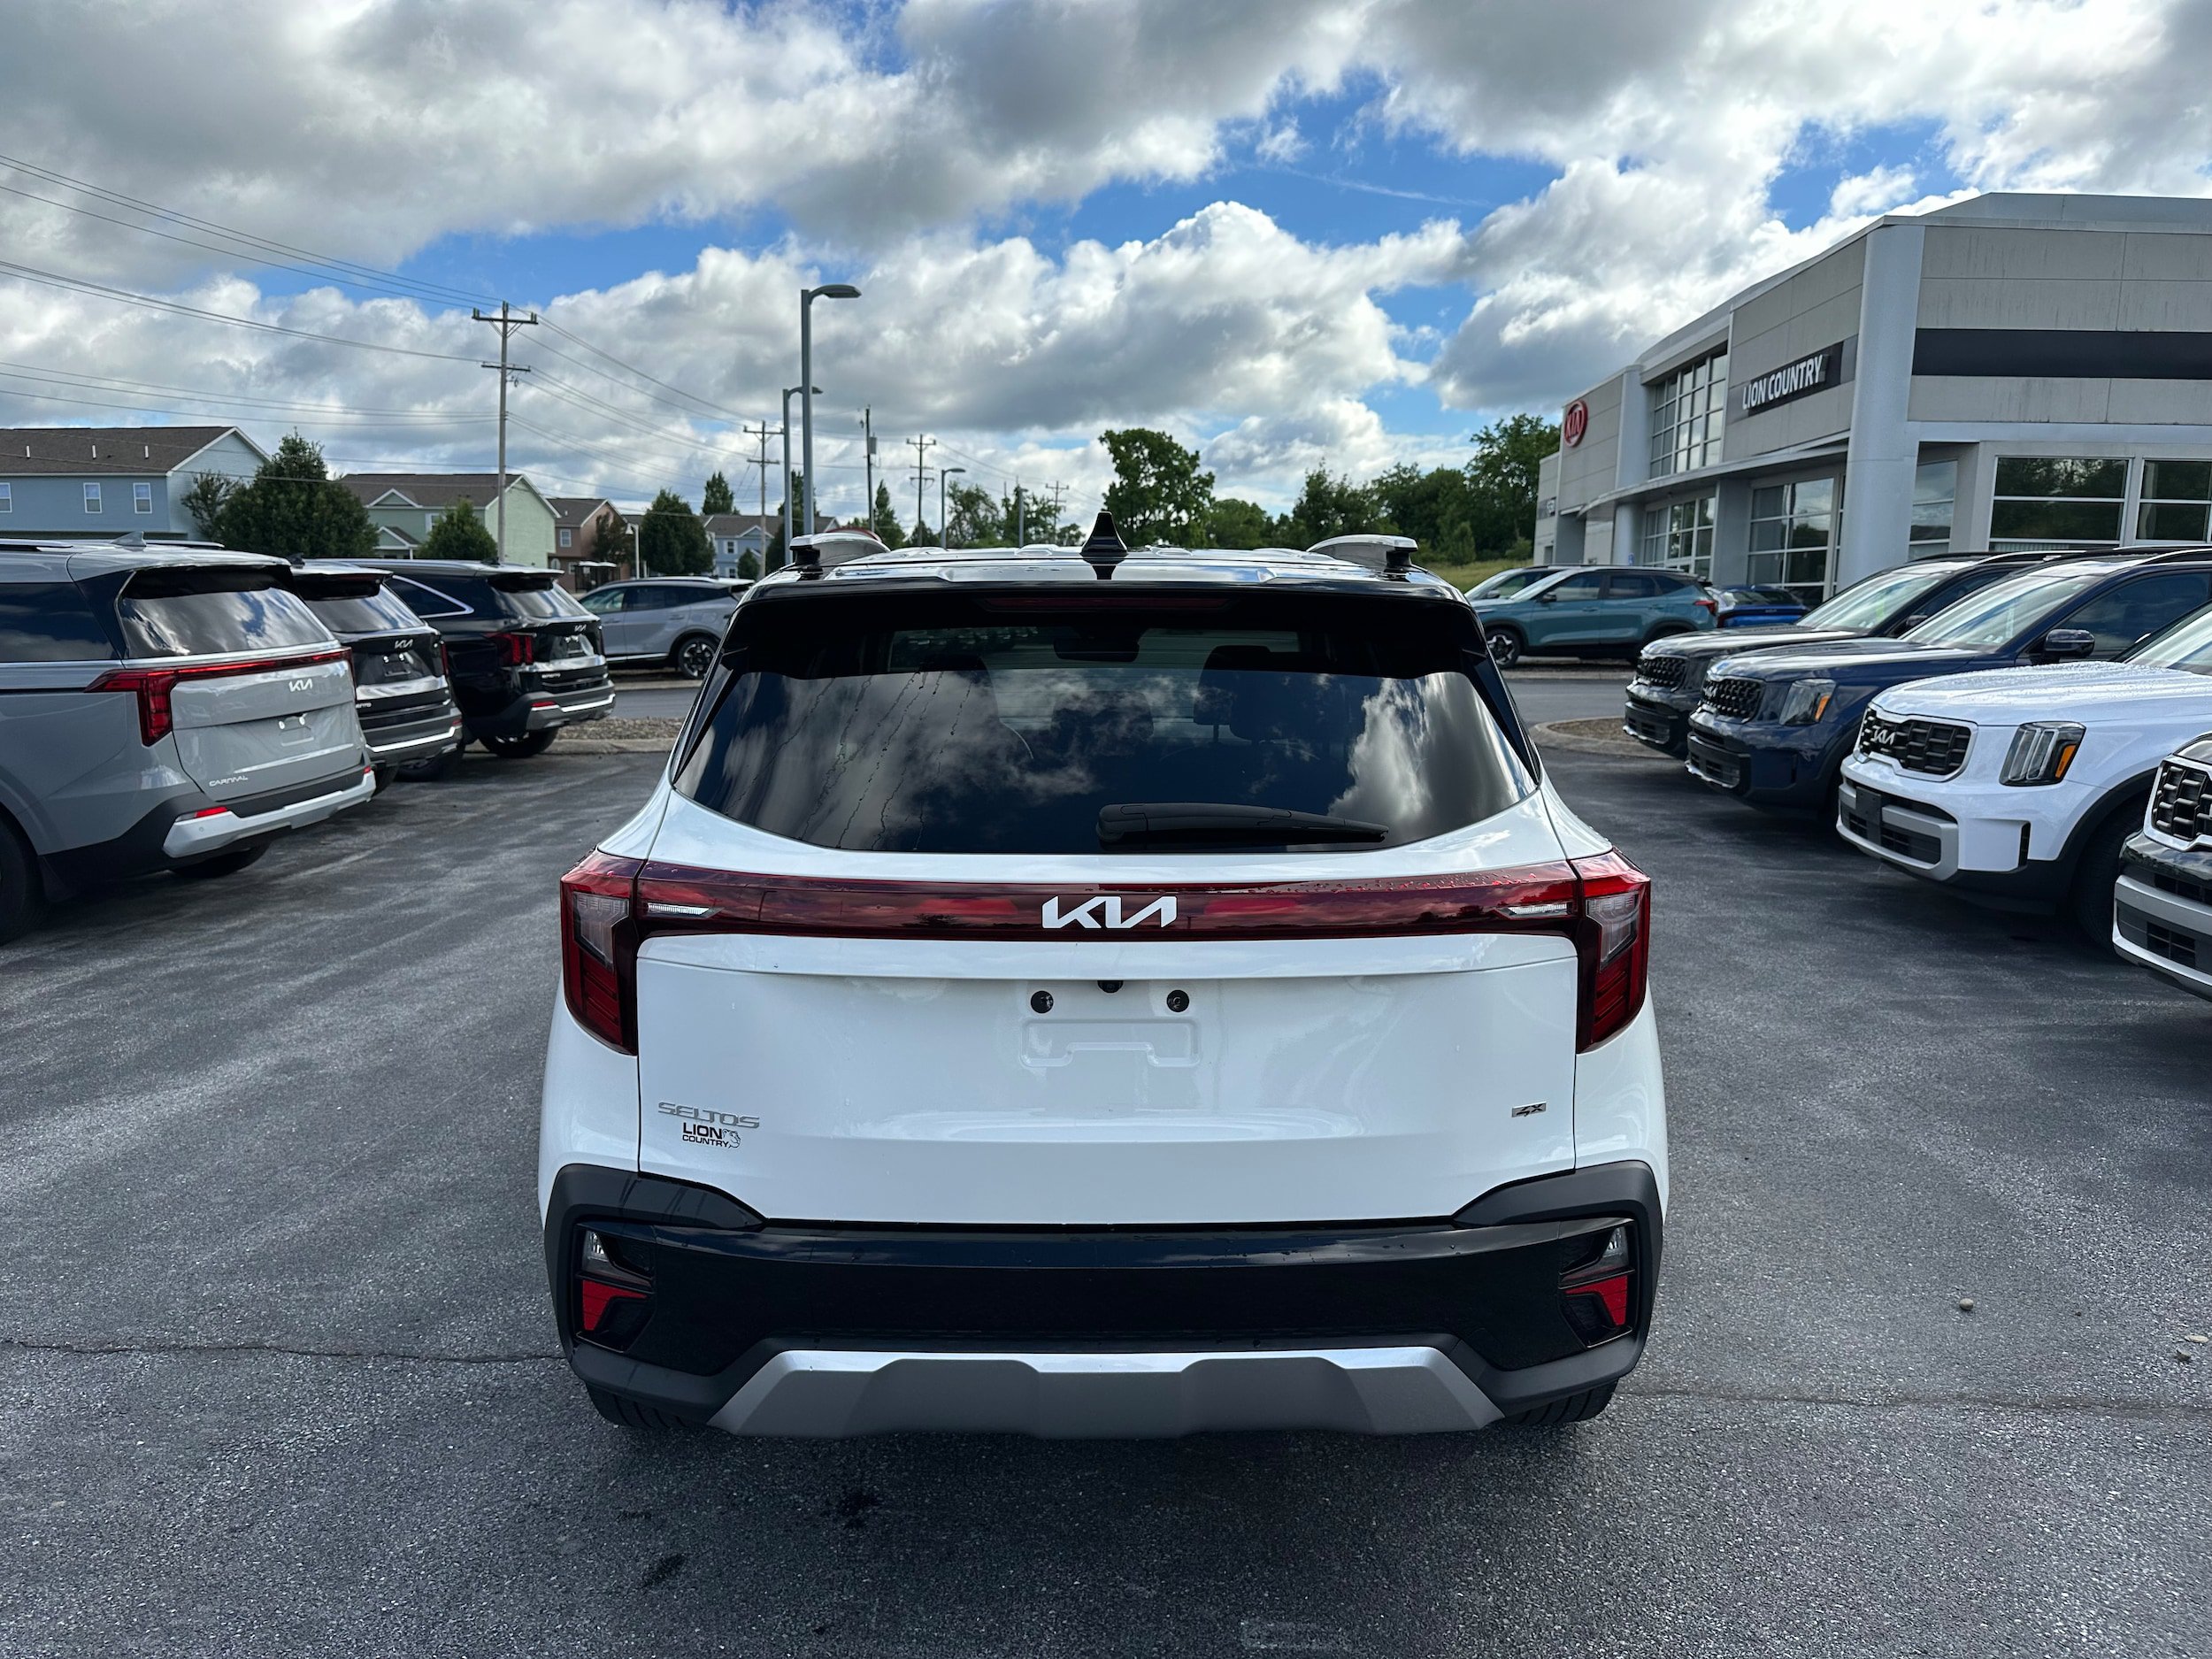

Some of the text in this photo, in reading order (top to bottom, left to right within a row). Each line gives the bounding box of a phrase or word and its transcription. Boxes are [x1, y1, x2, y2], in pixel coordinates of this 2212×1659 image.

[1742, 354, 1823, 411] LION COUNTRY
[394, 638, 414, 649] KIA
[288, 678, 313, 693] KIA
[1873, 727, 1896, 746] KIA
[1041, 895, 1178, 929] KIA
[657, 1102, 760, 1129] SELTOS
[683, 1122, 723, 1140] LION
[682, 1133, 729, 1148] COUNTRY
